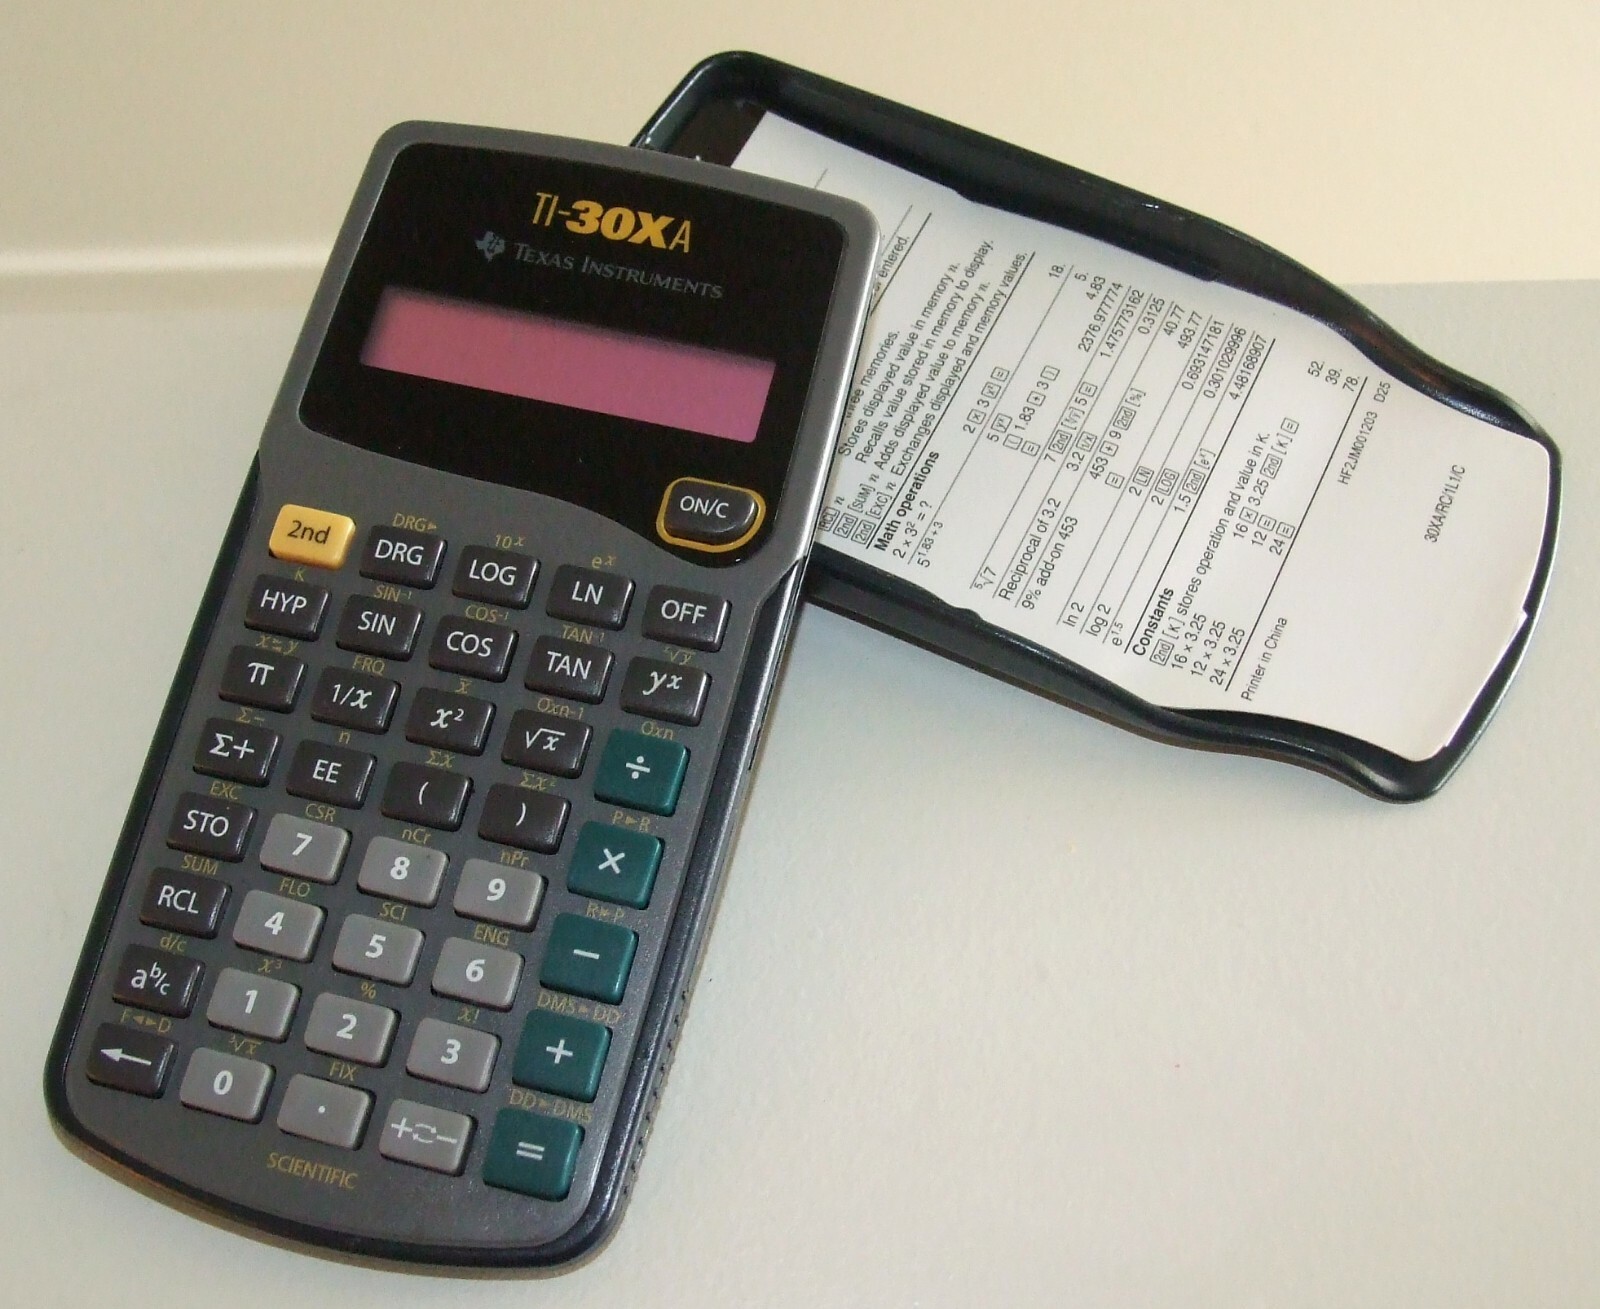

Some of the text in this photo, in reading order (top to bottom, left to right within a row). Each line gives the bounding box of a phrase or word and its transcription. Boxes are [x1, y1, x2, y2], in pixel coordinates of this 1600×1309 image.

[532, 192, 691, 253] TI-30XA
[878, 236, 910, 278] entered.
[514, 242, 724, 299] TEXAS INSTRUMENTS
[1085, 275, 1106, 301] 4.83
[1077, 282, 1124, 353] 2376.977774
[1099, 289, 1145, 358] 1.475773162
[1137, 297, 1166, 335] 0.3125
[1162, 304, 1186, 337] 40.77
[1177, 310, 1203, 350] 493.77
[836, 418, 869, 457] Stores
[862, 362, 901, 418] displayed
[894, 331, 919, 361] value
[910, 319, 927, 331] in
[921, 273, 955, 319] memory
[854, 240, 994, 464] Recalls value stored in memory to display.
[861, 331, 901, 387] memories.
[890, 412, 936, 477] Exchanges
[929, 356, 967, 412] displayed
[961, 333, 980, 357] and
[974, 288, 1007, 334] memory
[999, 252, 1028, 288] values.
[1181, 320, 1225, 391] 0.693147181
[1202, 326, 1247, 399] 0.301029996
[1229, 334, 1267, 401] 4.48168907
[1307, 360, 1325, 378] 52.
[1324, 368, 1343, 386] 39.
[873, 439, 900, 471] Adds
[893, 382, 931, 439] displayed
[925, 351, 949, 382] value
[941, 338, 957, 351] to
[951, 292, 985, 338] memory
[1341, 376, 1360, 392] 78.
[1372, 380, 1392, 403] D25
[1014, 405, 1036, 431] 1.83
[1247, 445, 1264, 458] in
[1255, 433, 1271, 444] K.
[1065, 451, 1086, 472] 3.2
[1089, 456, 1109, 480] 453
[1234, 458, 1257, 491] value
[833, 496, 846, 506] n
[873, 451, 940, 552] Math operations
[1128, 485, 1143, 497] 2
[1150, 494, 1165, 506] 2
[1173, 492, 1192, 513] 1.5
[1223, 490, 1242, 517] and
[680, 495, 729, 520] ON/C
[1232, 522, 1249, 539] 16
[1247, 477, 1270, 507] 3.25
[287, 519, 330, 546] 2nd
[1250, 530, 1268, 546] 12
[375, 539, 423, 566] DRG
[997, 497, 1062, 601] Reciprocal of 3.2
[1196, 518, 1230, 577] operation
[1268, 538, 1286, 556] 24
[468, 559, 516, 586] LOG
[1021, 515, 1079, 610] 9% add-on 453
[261, 589, 307, 615] HYP
[571, 581, 604, 606] LN
[1176, 576, 1202, 616] stores
[661, 600, 706, 625] OFF
[1070, 601, 1085, 614] 2
[1085, 603, 1112, 637] log 2
[358, 611, 396, 636] SIN
[1132, 587, 1175, 656] Constants
[446, 630, 493, 658] COS
[1170, 612, 1207, 669] 16 3.25
[1190, 620, 1226, 676] 12 3.25
[353, 655, 386, 677] FRQ
[546, 652, 592, 679] TAN
[1209, 627, 1246, 686] 24 3.25
[1240, 617, 1288, 702] Printer in China
[313, 760, 341, 784] EE
[209, 782, 241, 801] EXC
[182, 809, 230, 838] STO
[304, 802, 336, 823] CSR
[292, 832, 314, 857] 7
[401, 827, 432, 846] nCr
[181, 855, 218, 876] SUM
[390, 856, 411, 881] 8
[500, 848, 530, 869] nPr
[157, 885, 200, 914] RCL
[279, 878, 311, 898] FLO
[487, 877, 507, 902] 9
[264, 911, 284, 936] 4
[378, 902, 407, 922] SCI
[366, 934, 387, 959] 5
[474, 924, 510, 948] ENG
[466, 958, 487, 984] 6
[244, 991, 256, 1015] 1
[361, 981, 377, 1000] %
[336, 1014, 359, 1040] 2
[441, 1038, 463, 1065] 3
[213, 1070, 235, 1096] 0
[329, 1061, 358, 1082] FIX
[266, 1152, 359, 1191] SCIENTIFIC
